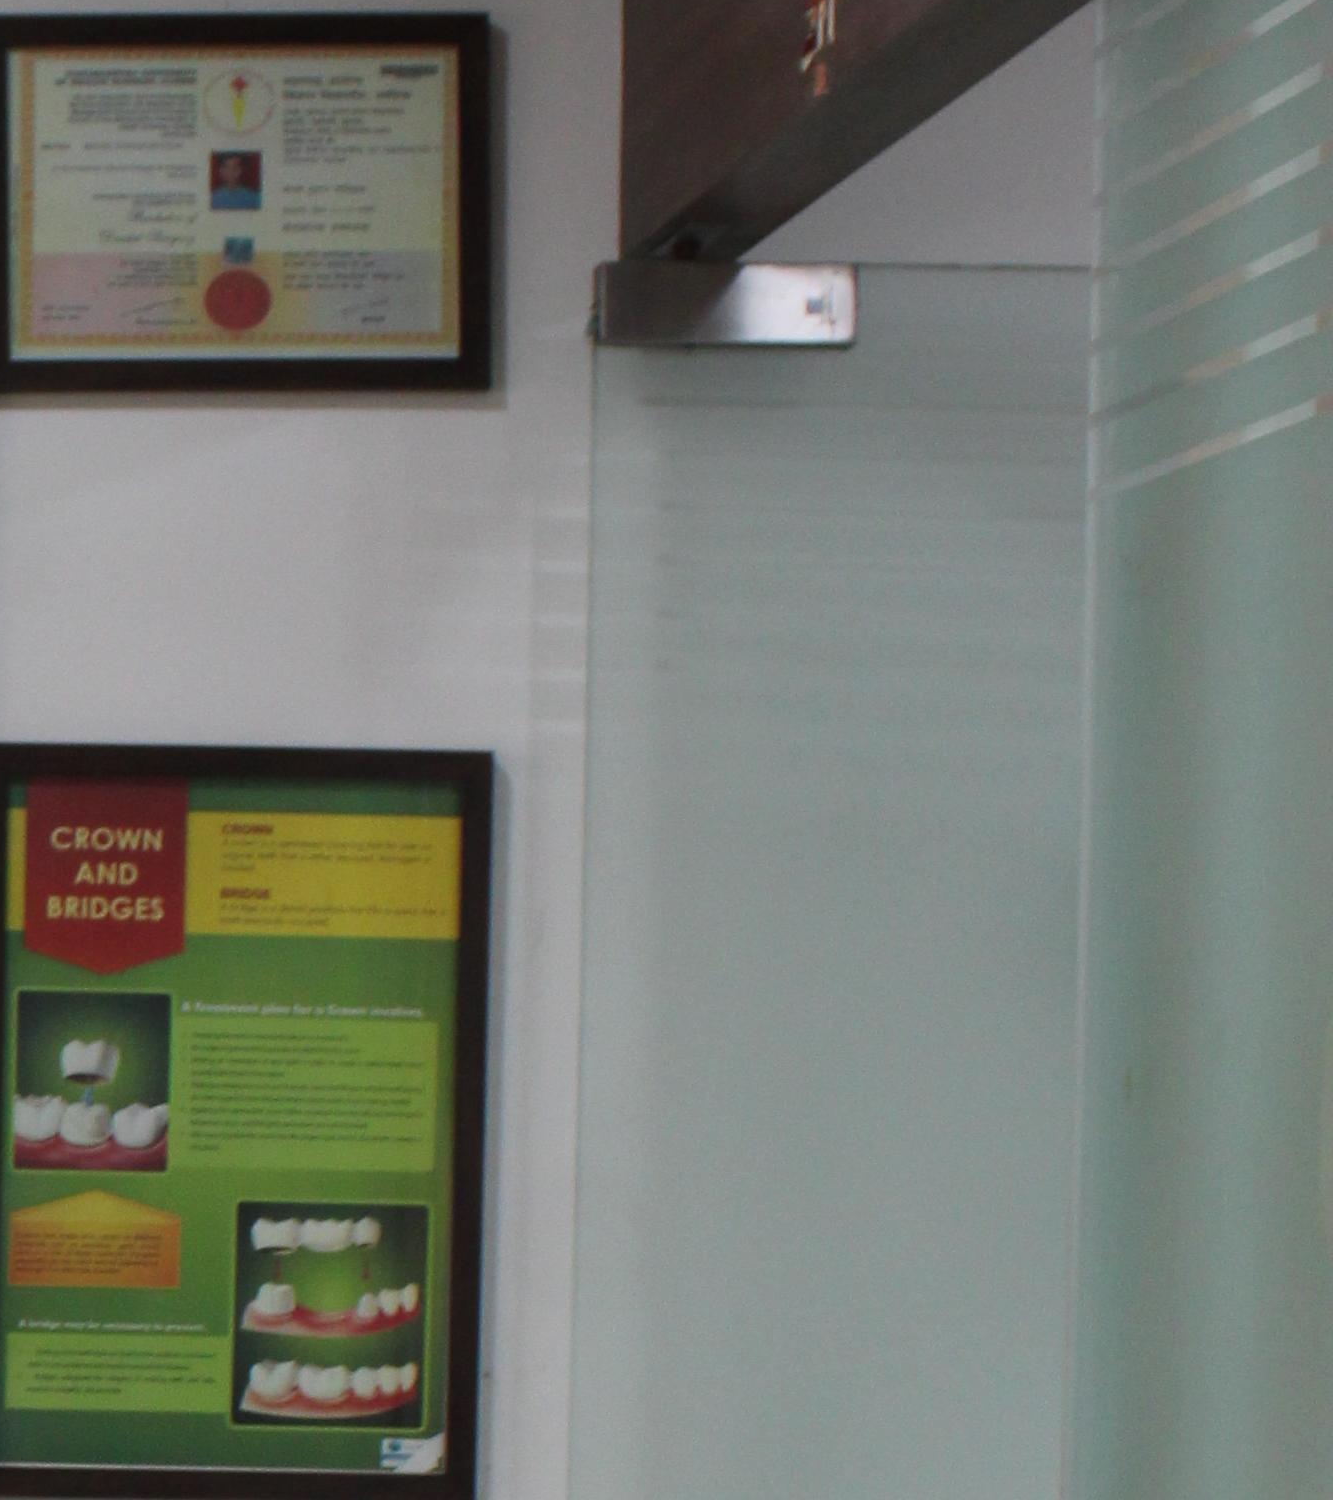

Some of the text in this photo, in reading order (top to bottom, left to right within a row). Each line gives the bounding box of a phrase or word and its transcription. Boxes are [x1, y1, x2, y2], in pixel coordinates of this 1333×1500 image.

[50, 825, 164, 851] CROWN
[74, 861, 138, 885] AND
[47, 895, 165, 921] BRIDGES
